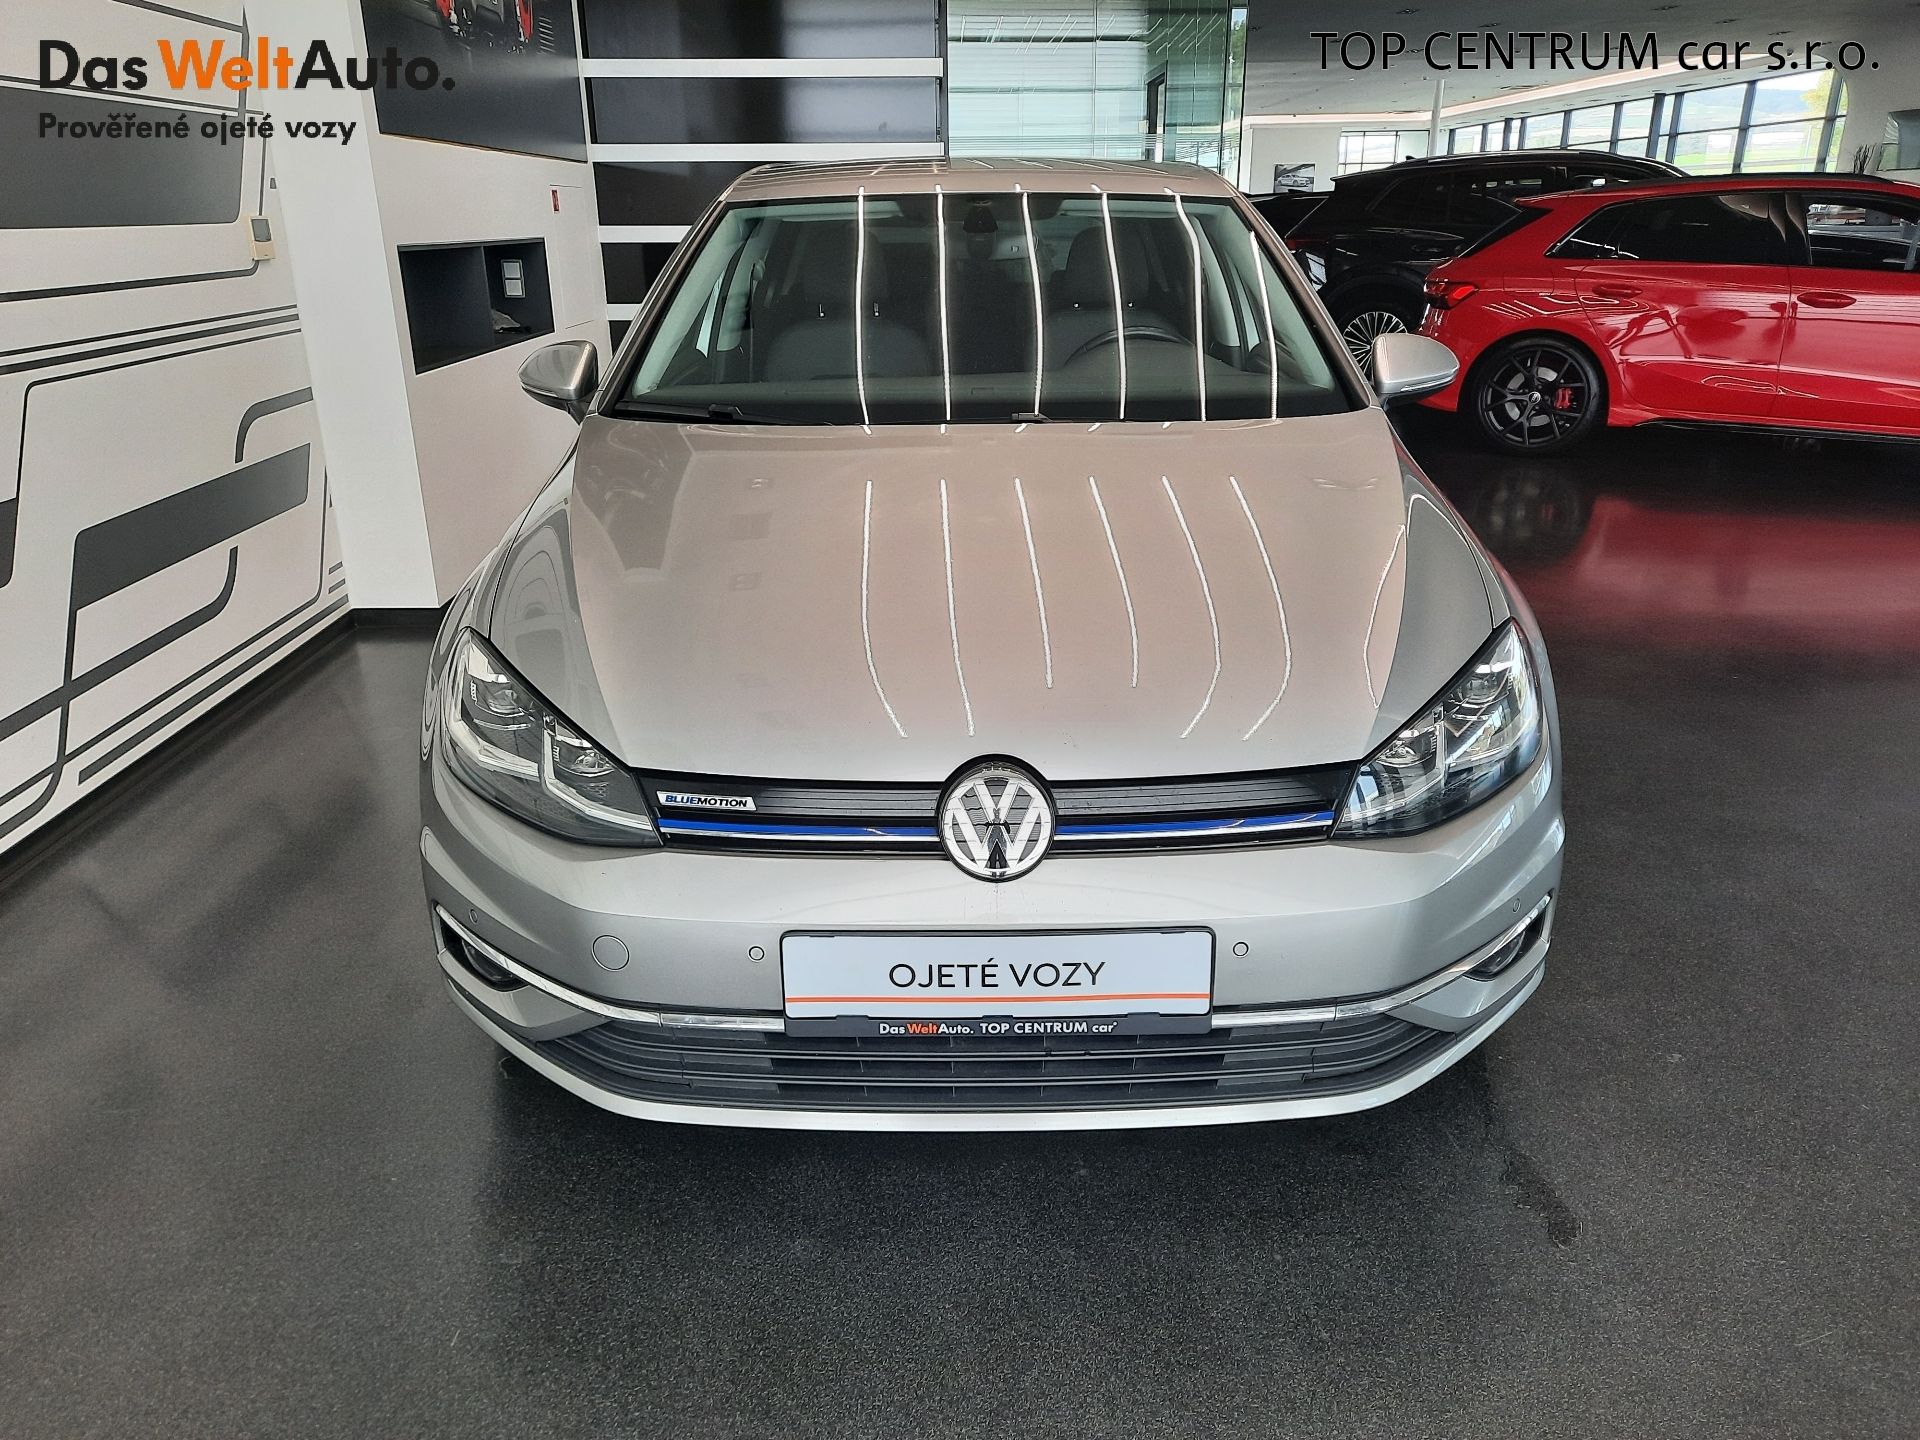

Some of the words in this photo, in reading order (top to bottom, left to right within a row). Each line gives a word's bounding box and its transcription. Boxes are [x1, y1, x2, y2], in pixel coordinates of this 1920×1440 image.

[665, 794, 748, 808] BLUEMOTION
[889, 957, 999, 988] OJETÉ
[1008, 961, 1106, 987] VOZY
[879, 1023, 906, 1035] Das
[907, 1022, 974, 1034] WeltAuto.
[980, 1022, 1010, 1034] TOP
[1014, 1022, 1088, 1034] CENTRUM
